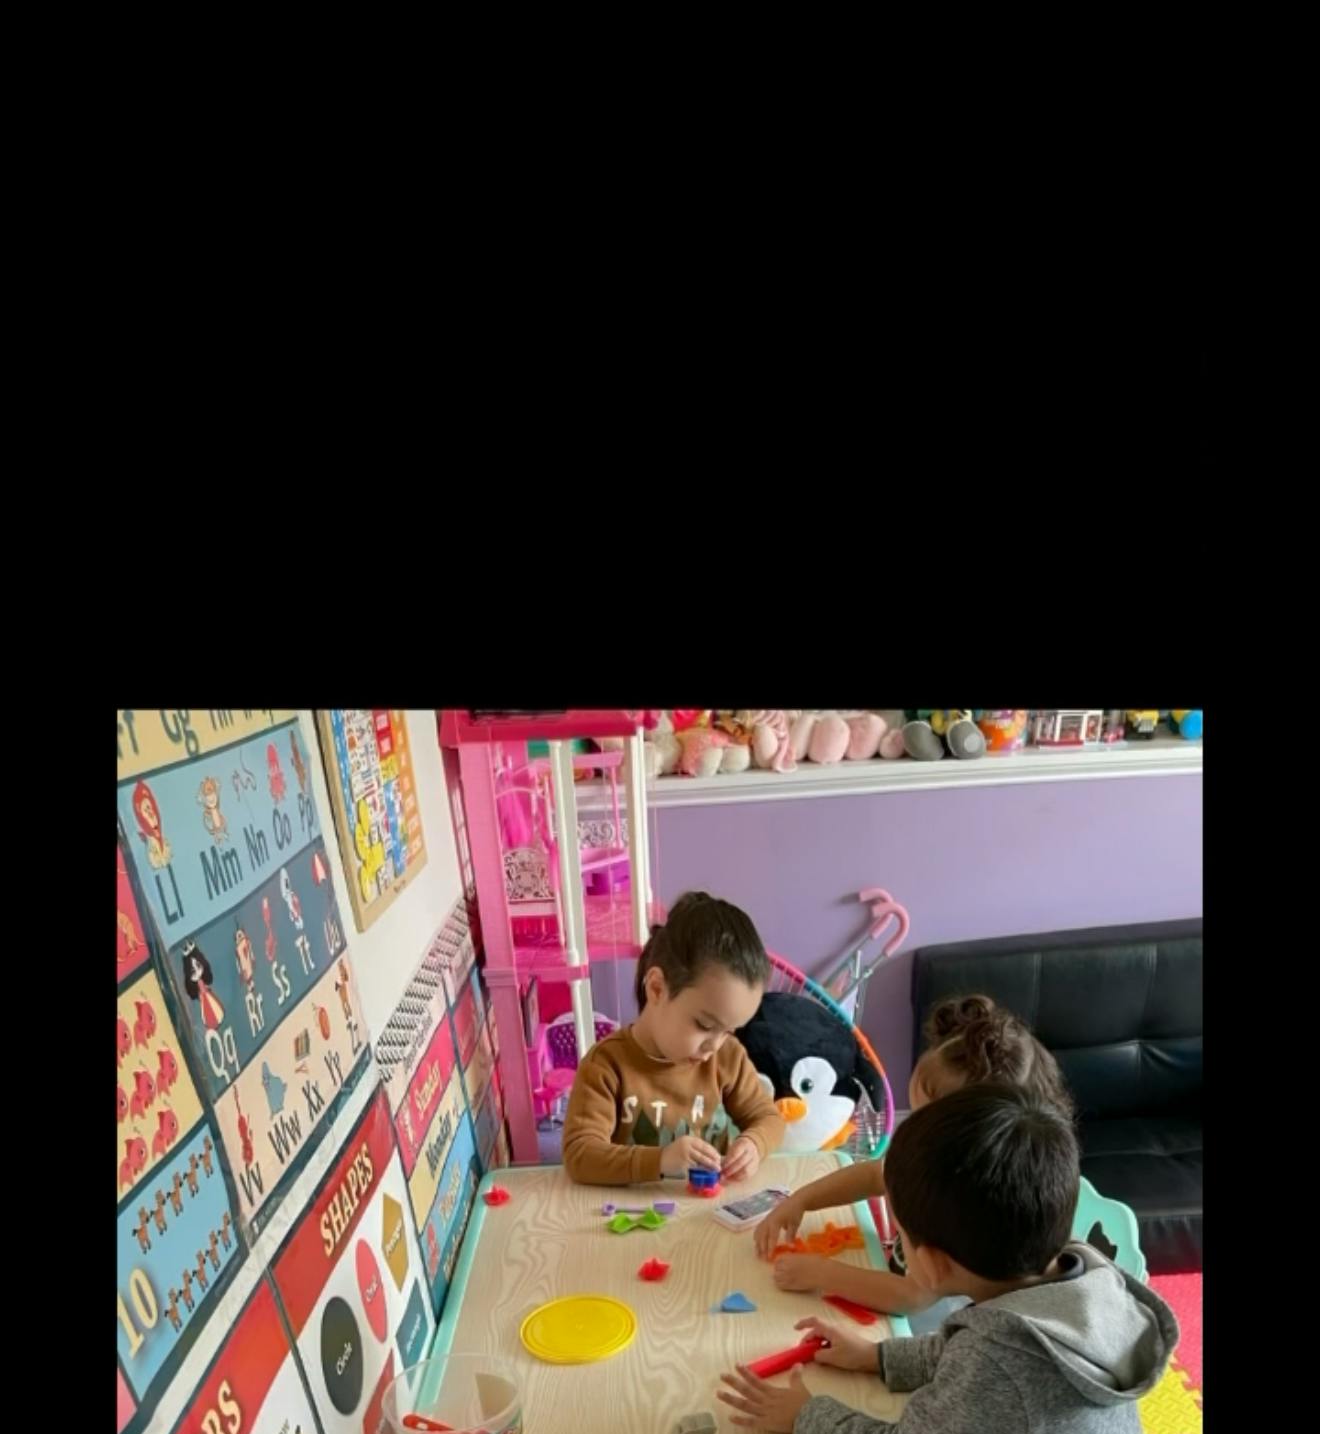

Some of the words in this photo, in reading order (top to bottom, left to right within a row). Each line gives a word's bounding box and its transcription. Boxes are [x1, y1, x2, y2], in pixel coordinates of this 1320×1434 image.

[155, 863, 184, 925] Ll
[200, 845, 243, 900] Mm
[243, 823, 270, 872] Nn
[272, 807, 292, 850] Oo
[205, 1026, 240, 1084] Qq
[245, 991, 265, 1038] Rr
[272, 960, 291, 1006] Ss
[295, 934, 315, 976] Tt
[239, 1159, 264, 1208] Vv
[267, 1108, 302, 1165] Ww
[302, 1079, 326, 1122] Xx
[320, 1142, 374, 1258] SHAPES
[117, 1268, 158, 1359] 10
[336, 1341, 353, 1376] Circle
